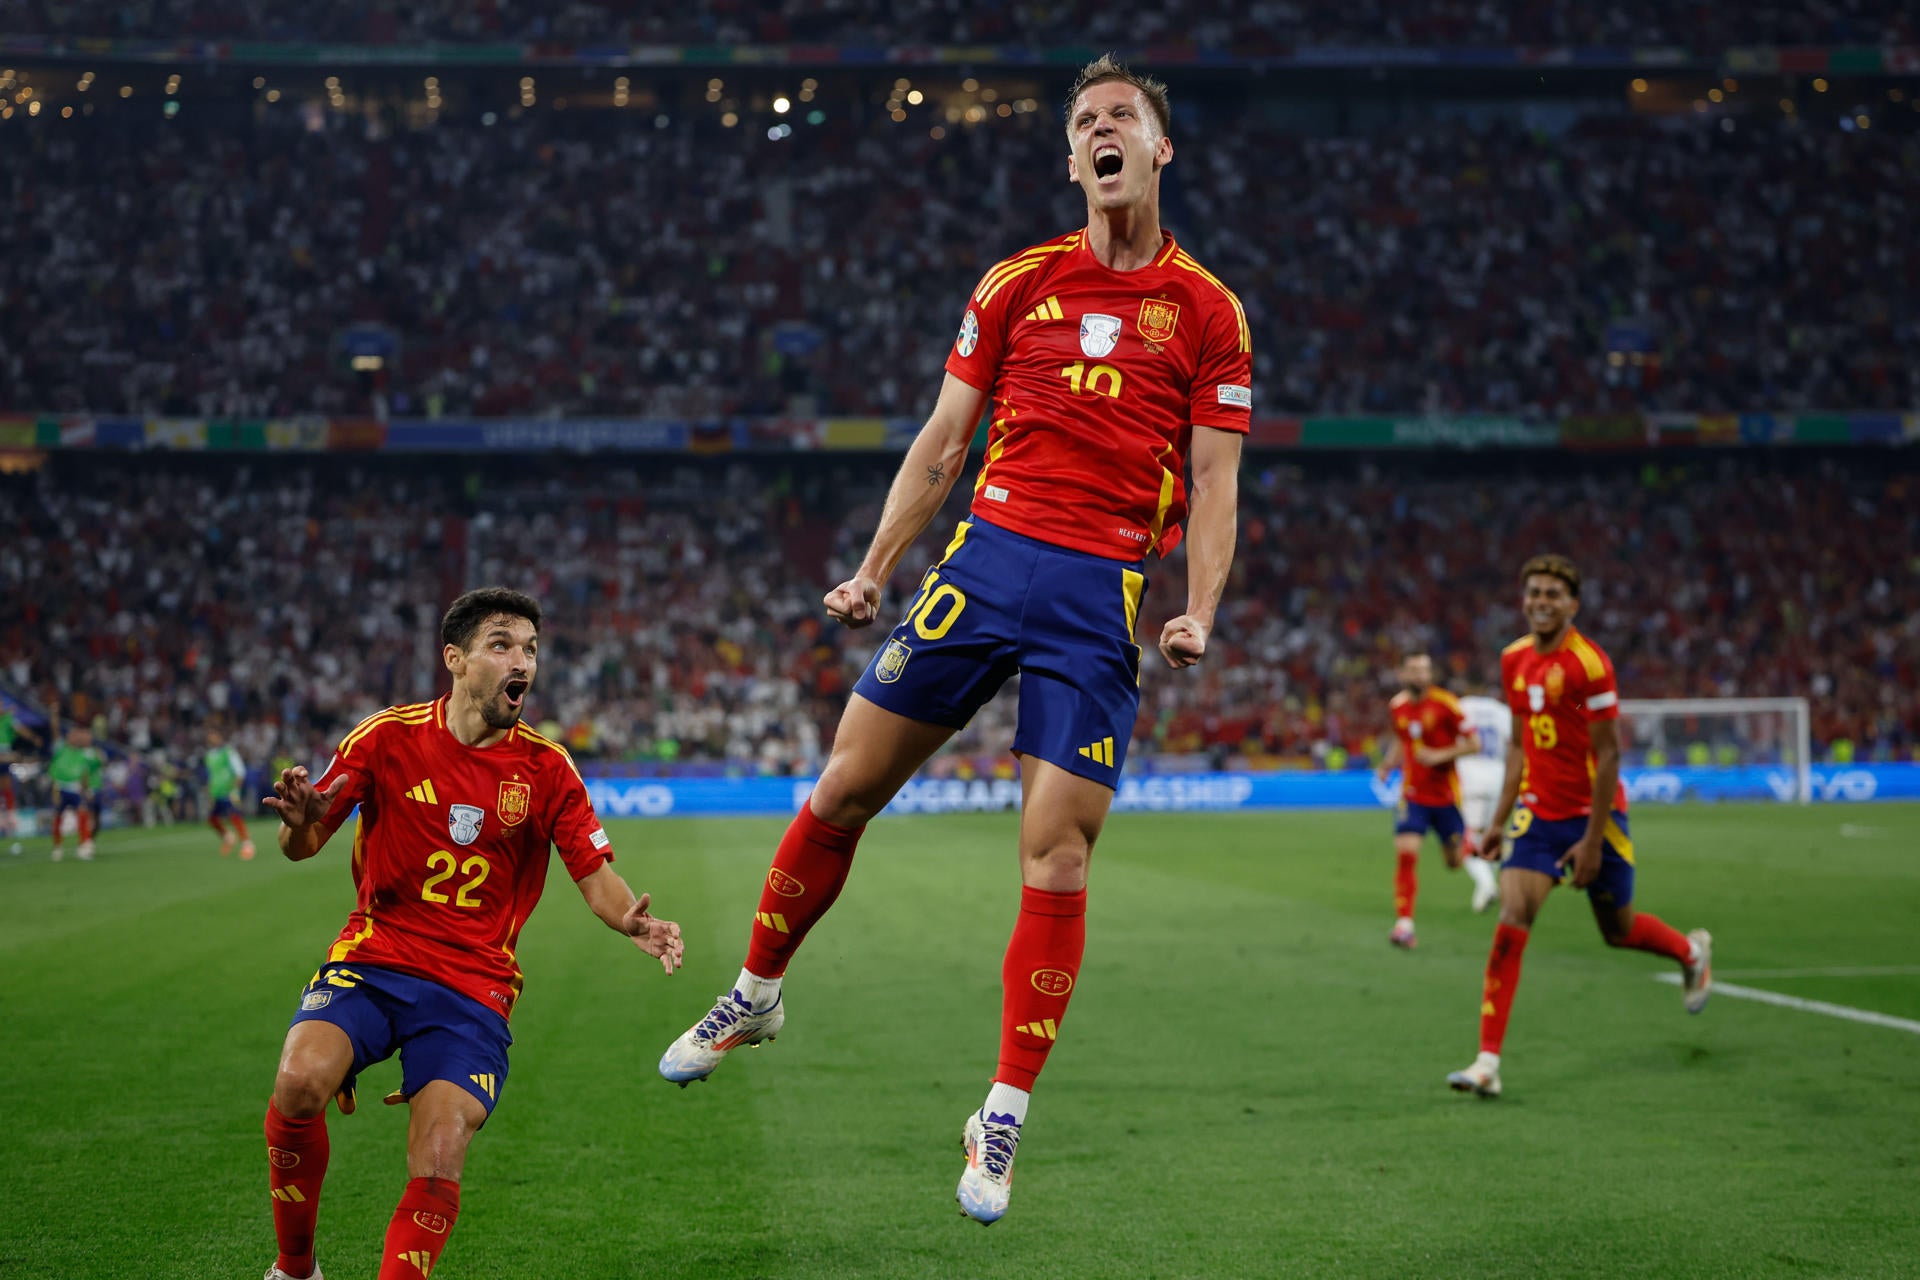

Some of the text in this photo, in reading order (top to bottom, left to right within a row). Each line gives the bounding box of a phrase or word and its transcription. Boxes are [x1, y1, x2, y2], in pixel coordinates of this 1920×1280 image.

[1060, 360, 1123, 399] 10
[902, 571, 967, 640] 10
[1528, 713, 1558, 750] 19
[588, 779, 675, 816] ivo
[1110, 776, 1253, 811] AGSHIP
[421, 850, 491, 908] 22
